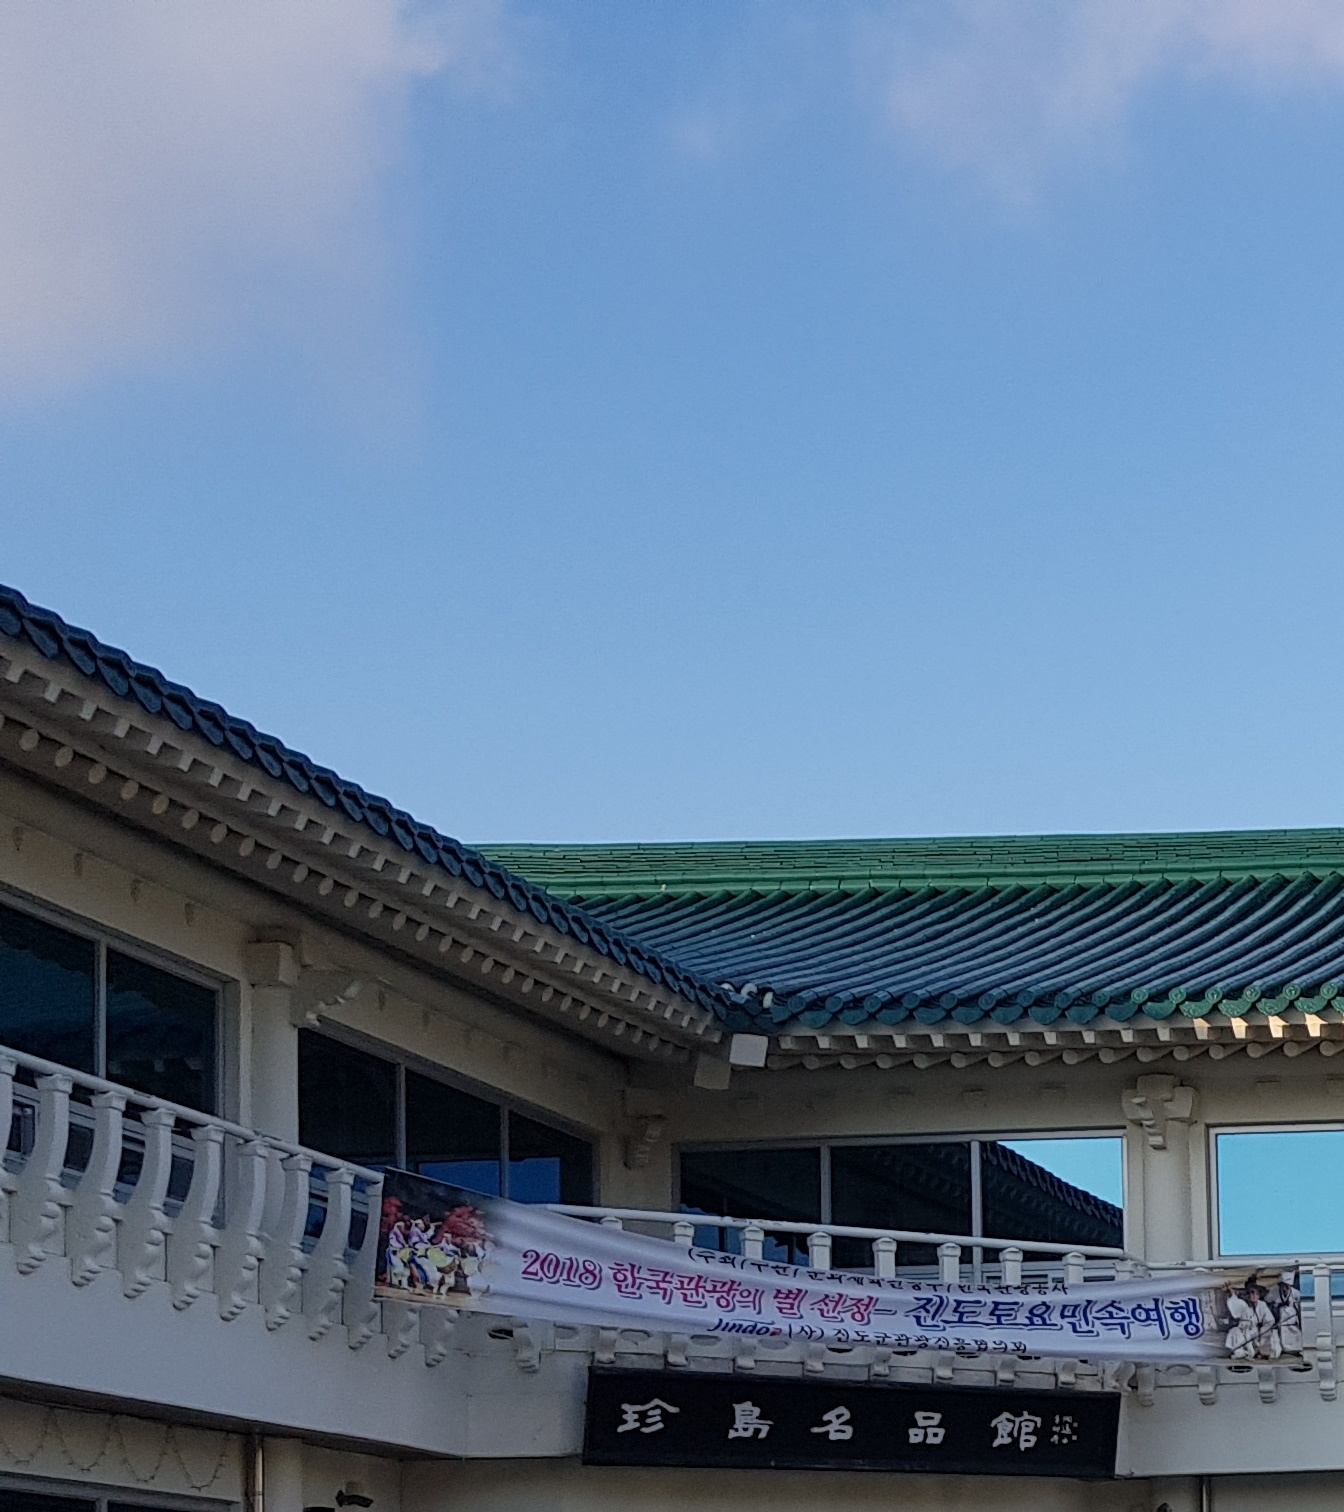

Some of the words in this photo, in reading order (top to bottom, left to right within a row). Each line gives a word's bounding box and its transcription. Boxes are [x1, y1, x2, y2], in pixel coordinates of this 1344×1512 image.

[521, 1248, 601, 1293] 2018
[608, 1260, 764, 1315] 한국관광의
[772, 1286, 808, 1320] 별
[904, 1293, 1205, 1341] 진도토요민속여행
[616, 1397, 1043, 1451] 珍島名品館
